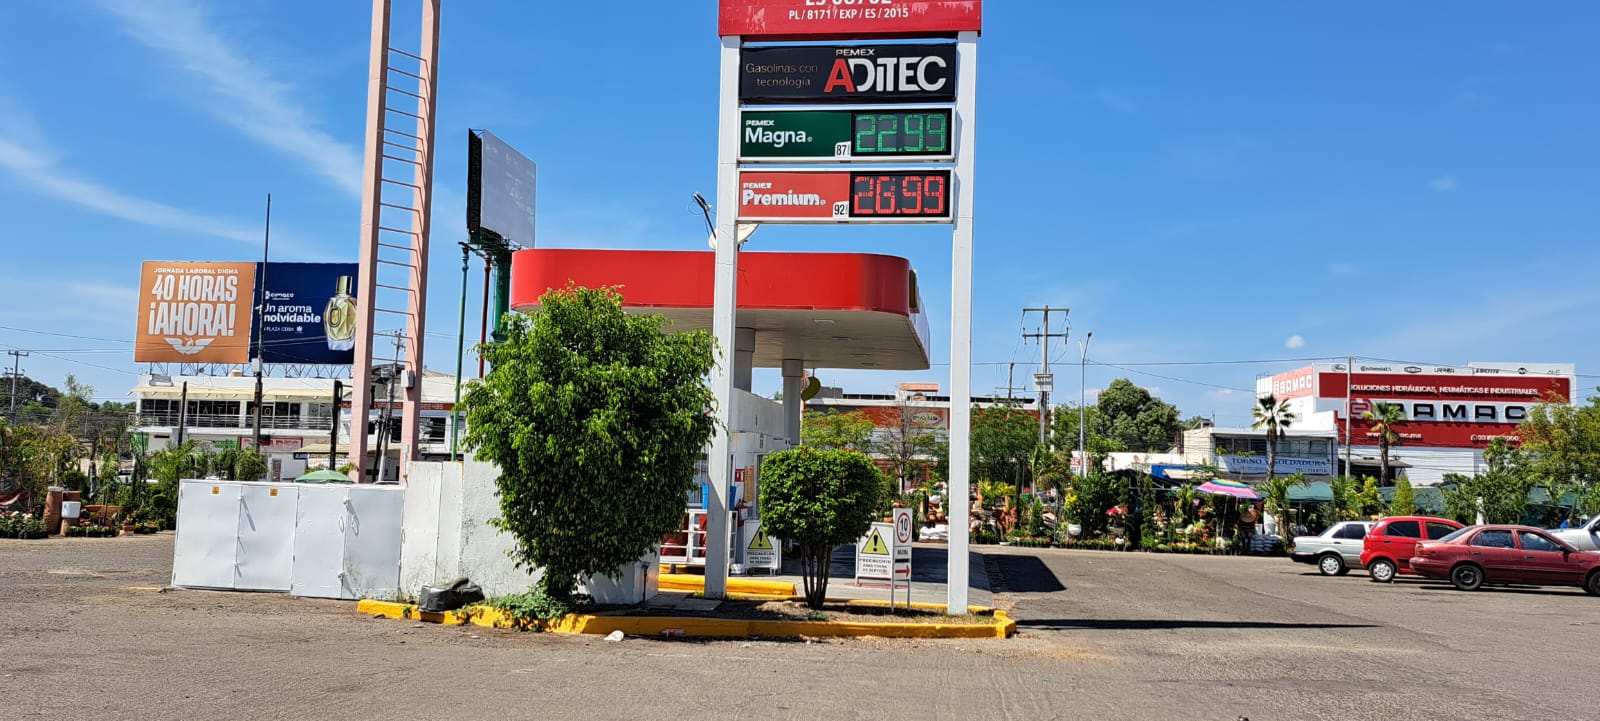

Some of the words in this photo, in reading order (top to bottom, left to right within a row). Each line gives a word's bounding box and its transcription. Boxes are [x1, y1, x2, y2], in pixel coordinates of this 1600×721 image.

[789, 10, 800, 20] PL
[807, 9, 831, 19] 8171
[840, 9, 857, 19] EXP
[865, 8, 876, 18] ES
[884, 8, 909, 18] 2015
[836, 48, 875, 57] PEMEX
[745, 63, 796, 73] Gasolinas
[799, 65, 818, 73] con
[856, 114, 946, 152] 22.99
[836, 144, 847, 156] 87
[853, 175, 944, 214] 26.99
[834, 204, 845, 215] 92
[151, 274, 175, 301] 40
[177, 275, 238, 302] HORAS
[277, 305, 312, 313] aroma
[148, 302, 236, 337] ¡AHORA!
[263, 313, 321, 323] nolvidable
[900, 518, 909, 532] 10
